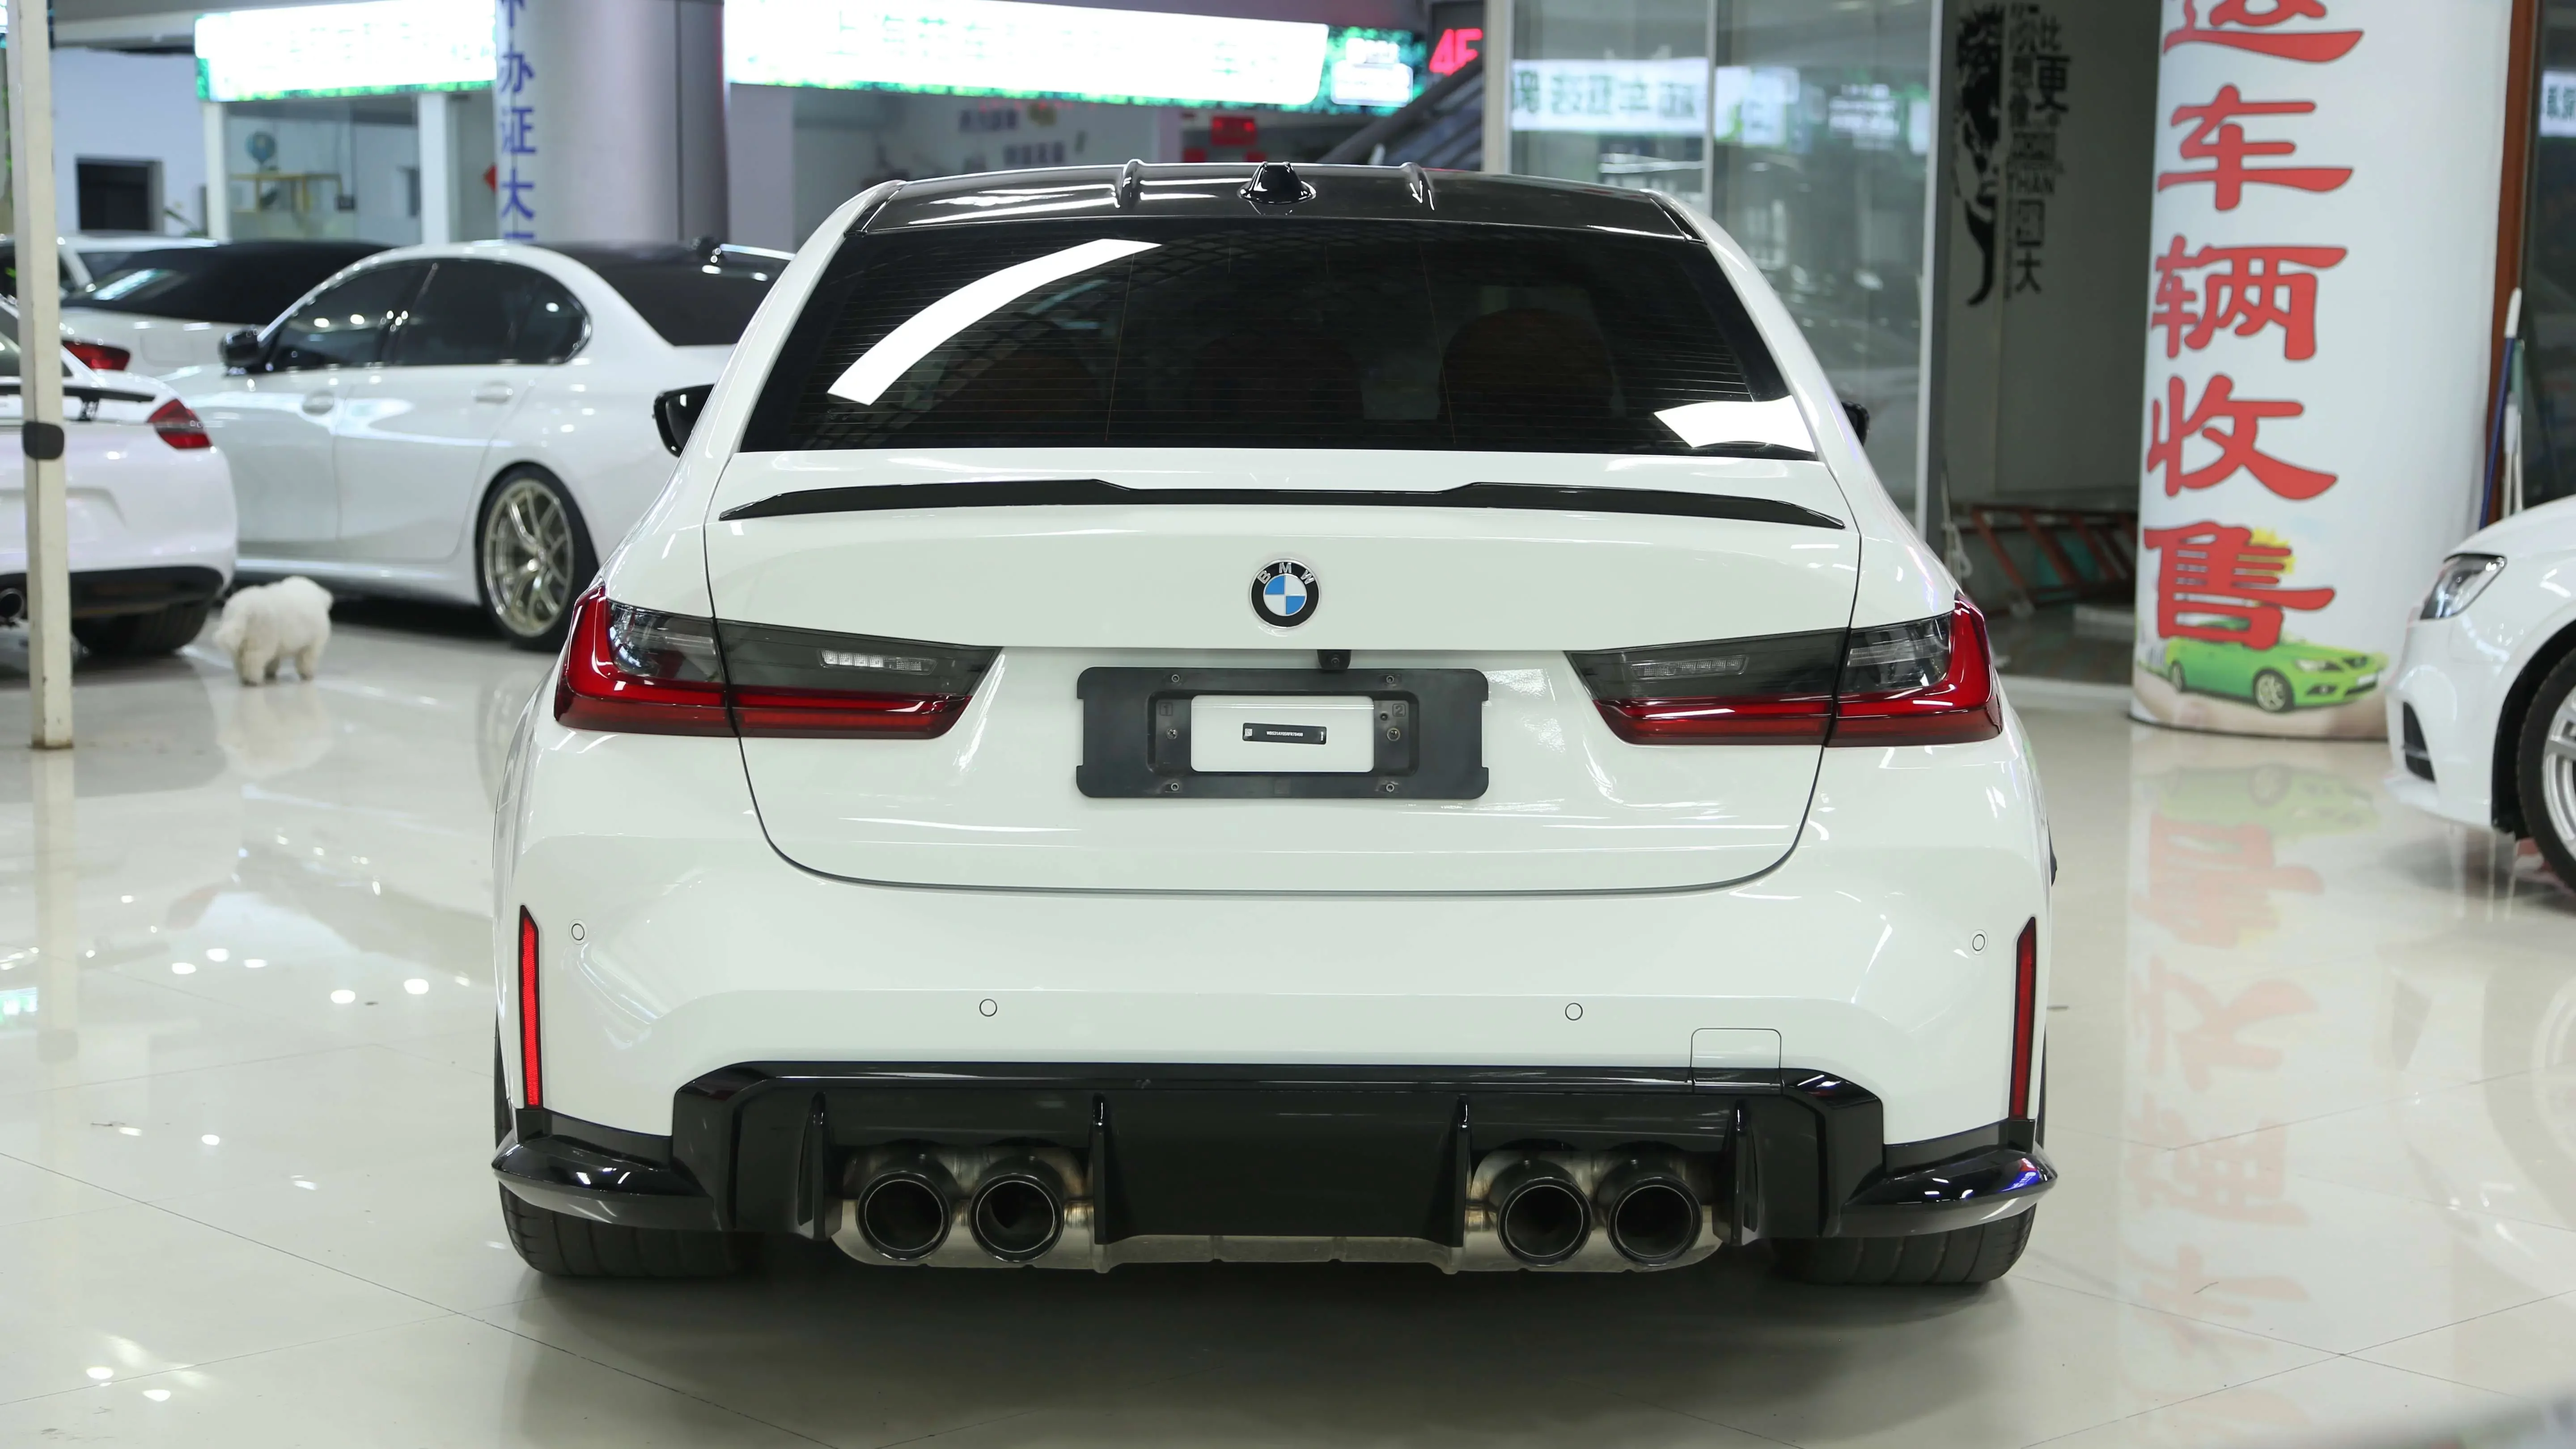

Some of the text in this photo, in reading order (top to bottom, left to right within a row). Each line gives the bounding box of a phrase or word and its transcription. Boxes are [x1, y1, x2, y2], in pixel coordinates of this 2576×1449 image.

[1429, 28, 1483, 77] 4F
[500, 0, 536, 239] 办证大
[1257, 562, 1315, 585] BMW
[1395, 705, 1403, 716] 2
